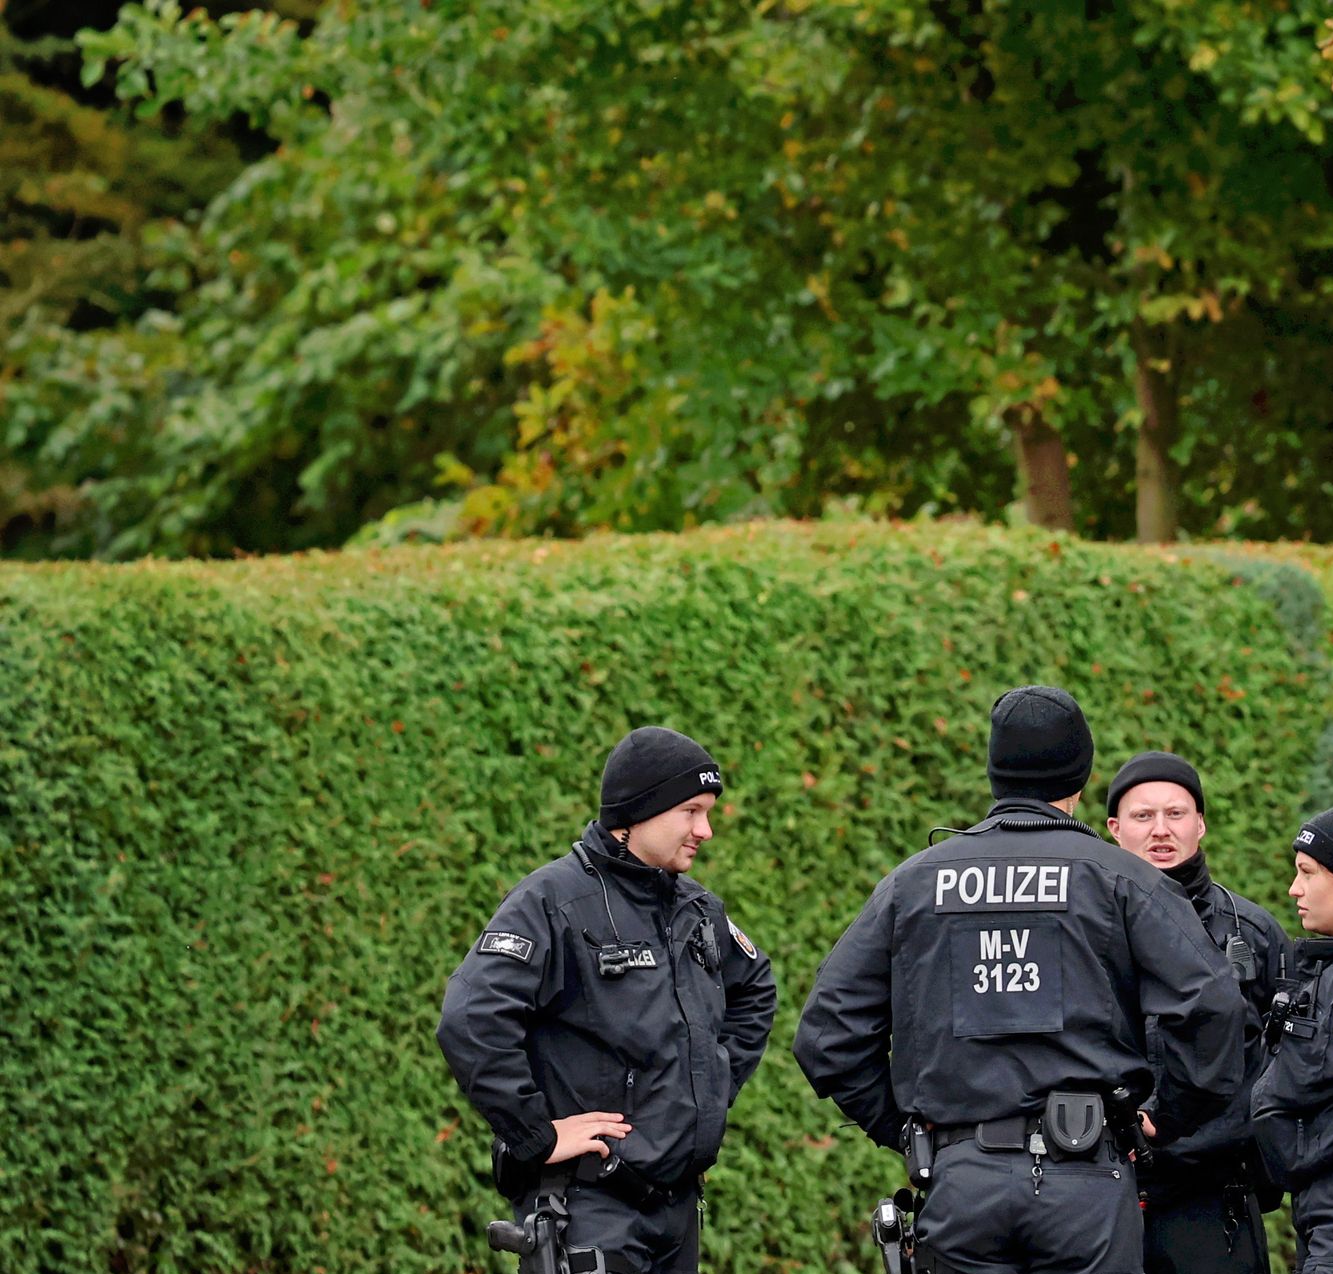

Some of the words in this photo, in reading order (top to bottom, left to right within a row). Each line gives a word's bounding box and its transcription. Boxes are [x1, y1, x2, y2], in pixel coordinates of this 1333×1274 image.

[1296, 829, 1316, 845] ZEI
[935, 866, 1070, 906] POLIZEI
[618, 949, 657, 967] LIZEI
[979, 928, 1031, 961] M-V
[973, 962, 1041, 994] 3123
